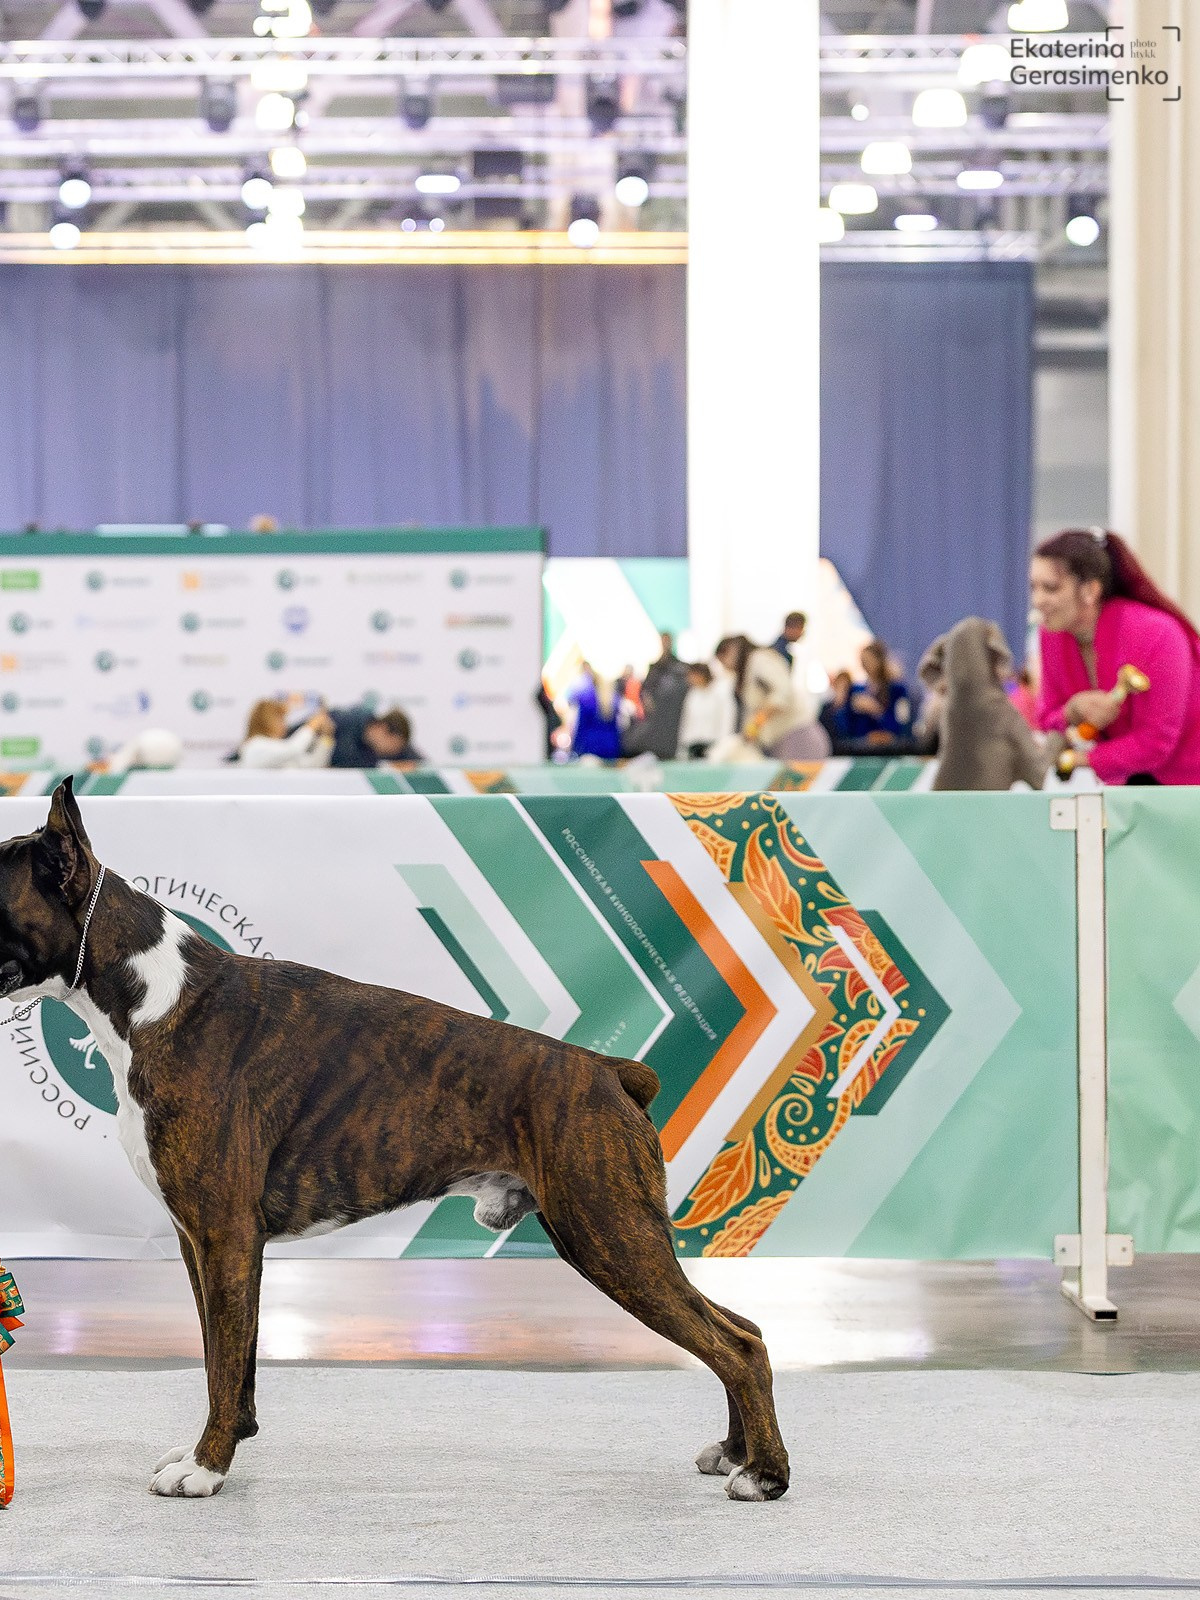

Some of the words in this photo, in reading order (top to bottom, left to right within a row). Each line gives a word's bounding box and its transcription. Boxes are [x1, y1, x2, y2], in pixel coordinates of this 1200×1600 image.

[132, 876, 275, 960] ОГИЧЕСКА
[562, 828, 613, 896] РОССИЙСКАЯ
[609, 893, 677, 984] КИНОЛОГИЧЕСКАЯ
[673, 983, 718, 1041] ФЕДЕРАЦИЯ
[10, 1004, 91, 1130] РОССИЙС
